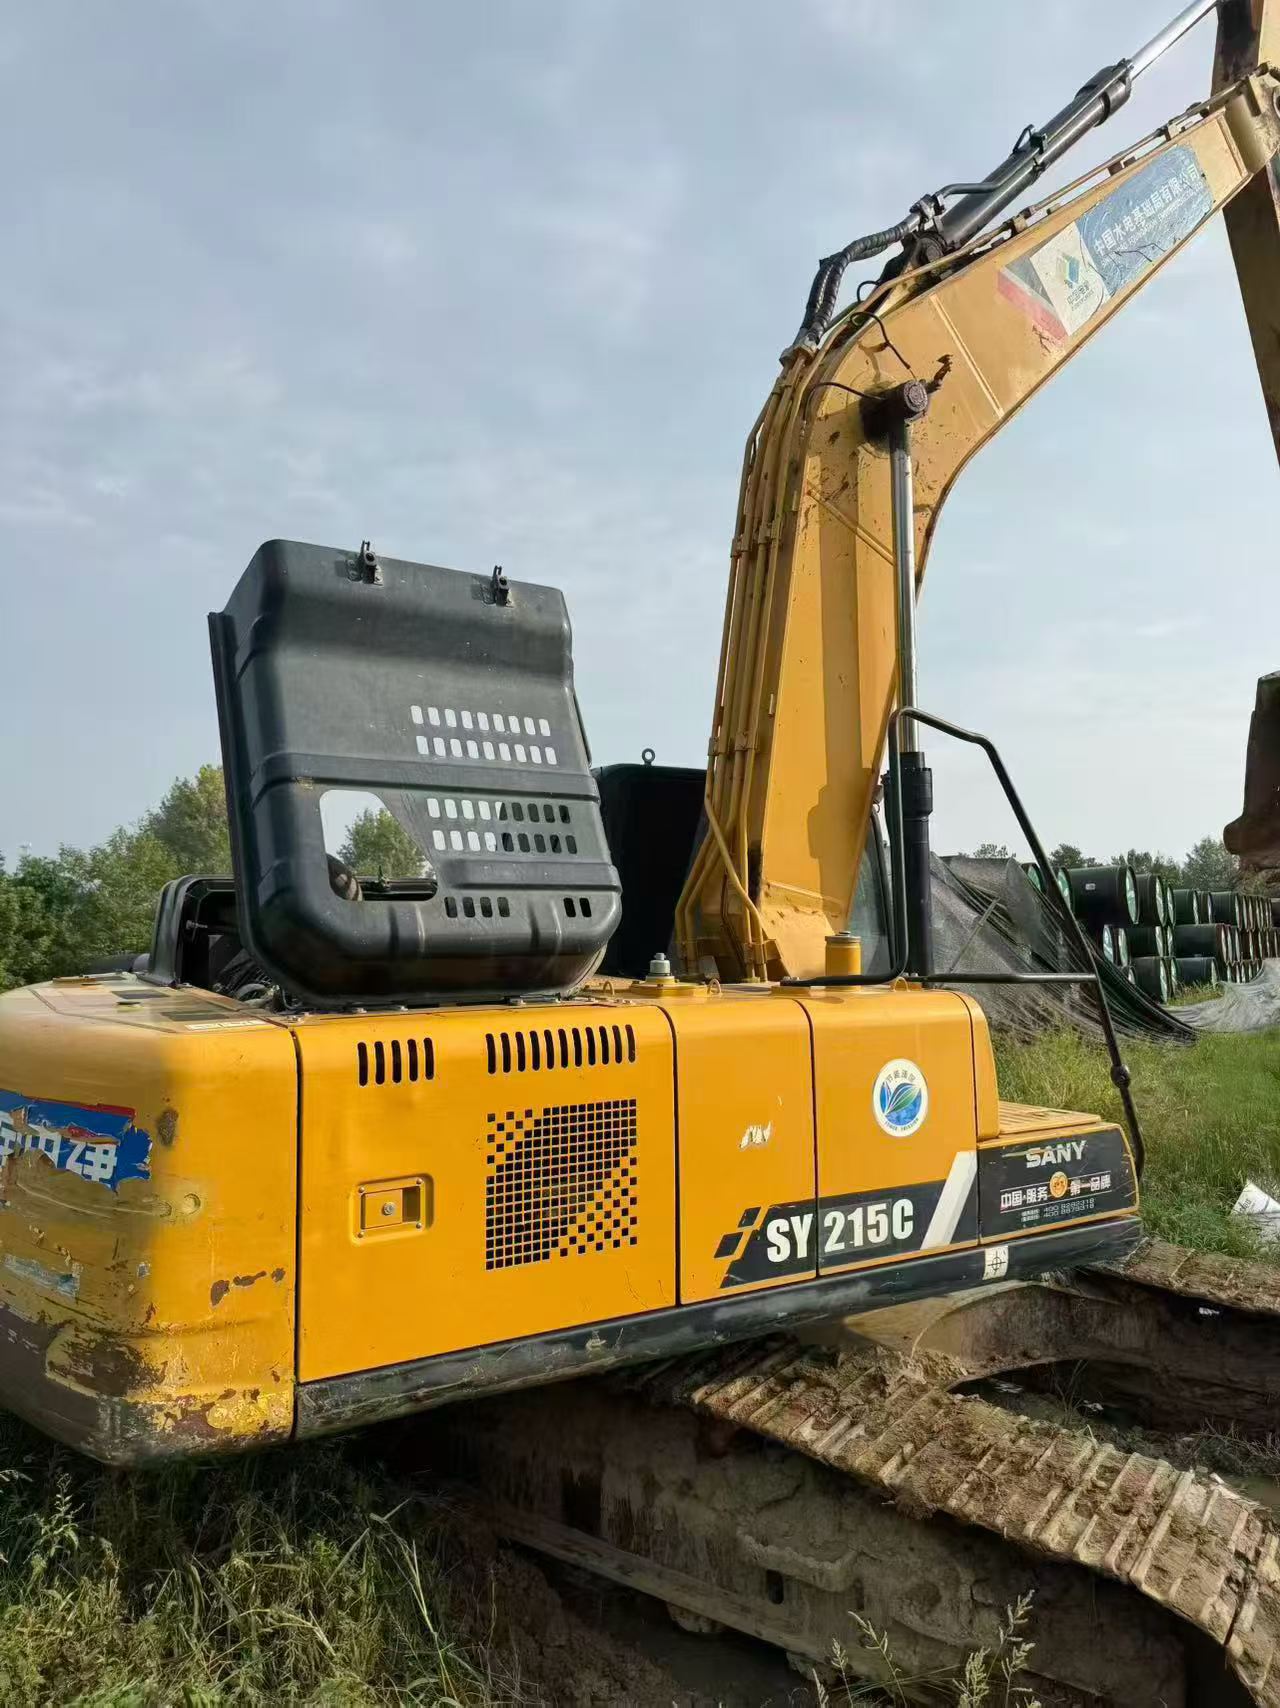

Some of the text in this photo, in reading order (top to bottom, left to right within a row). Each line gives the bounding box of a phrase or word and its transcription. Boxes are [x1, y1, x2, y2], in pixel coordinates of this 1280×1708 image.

[1026, 1140, 1086, 1168] SANY
[1070, 1175, 1111, 1196] 第一品牌
[766, 1199, 914, 1263] SY 215C
